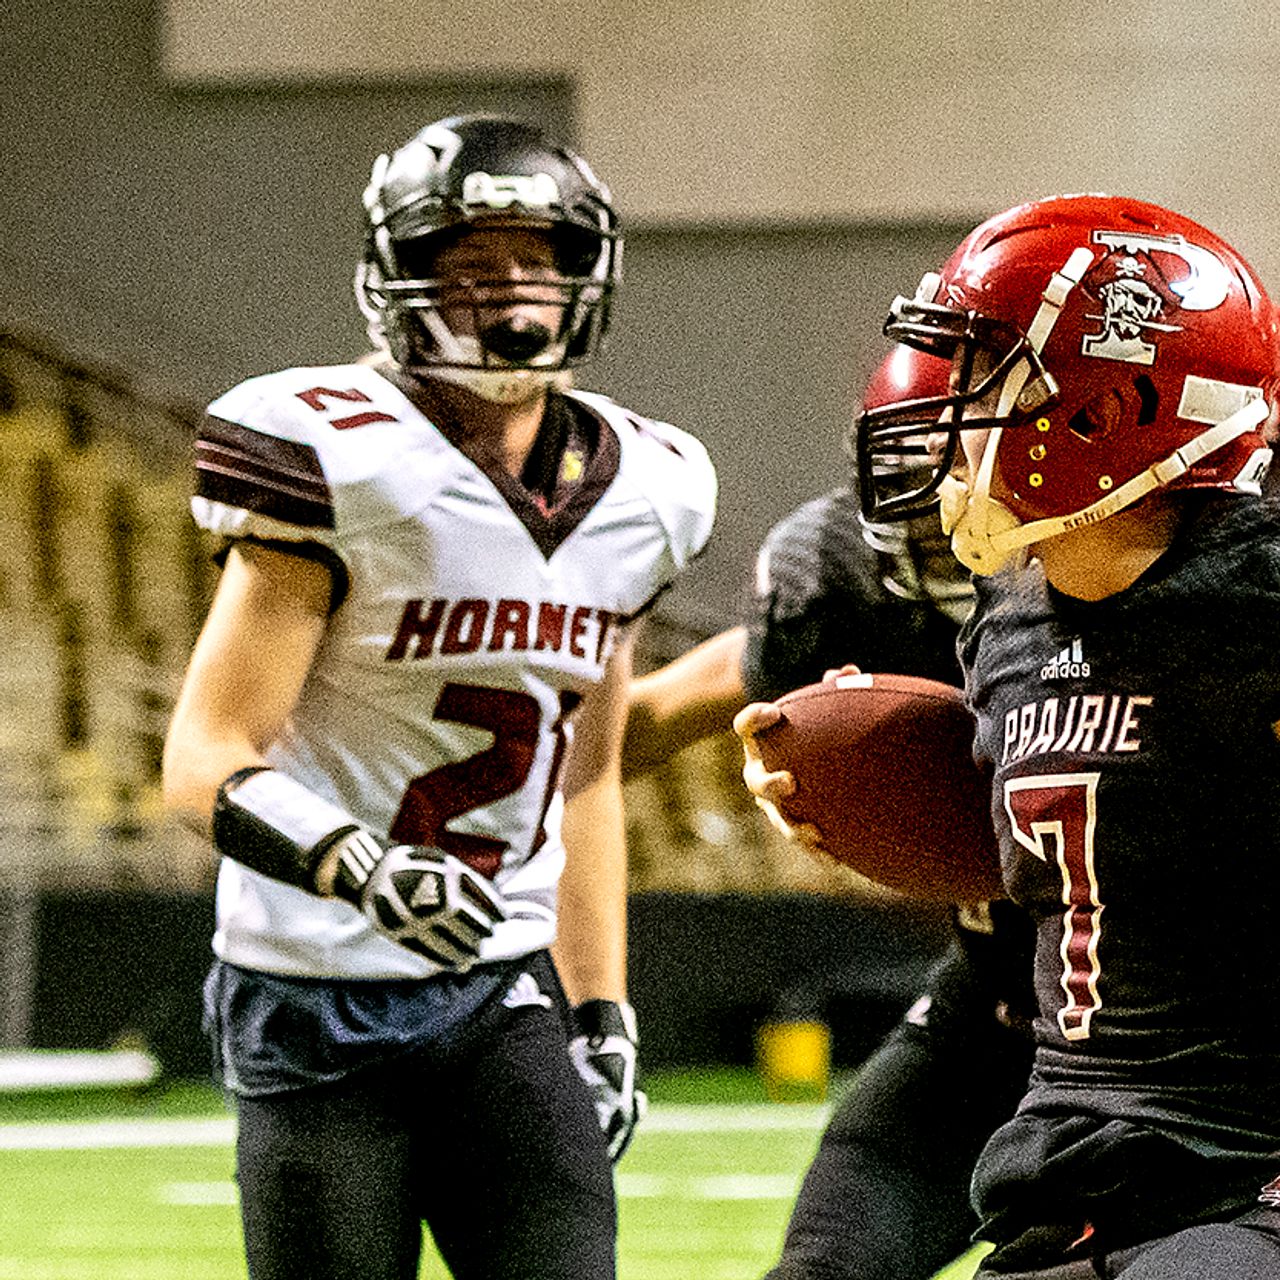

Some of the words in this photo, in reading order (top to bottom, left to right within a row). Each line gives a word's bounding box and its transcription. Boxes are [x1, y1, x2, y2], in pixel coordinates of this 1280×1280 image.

[294, 386, 400, 431] 21
[1039, 660, 1091, 681] adidas
[1001, 694, 1154, 768] PRAIRIE
[1004, 772, 1106, 1042] 7
